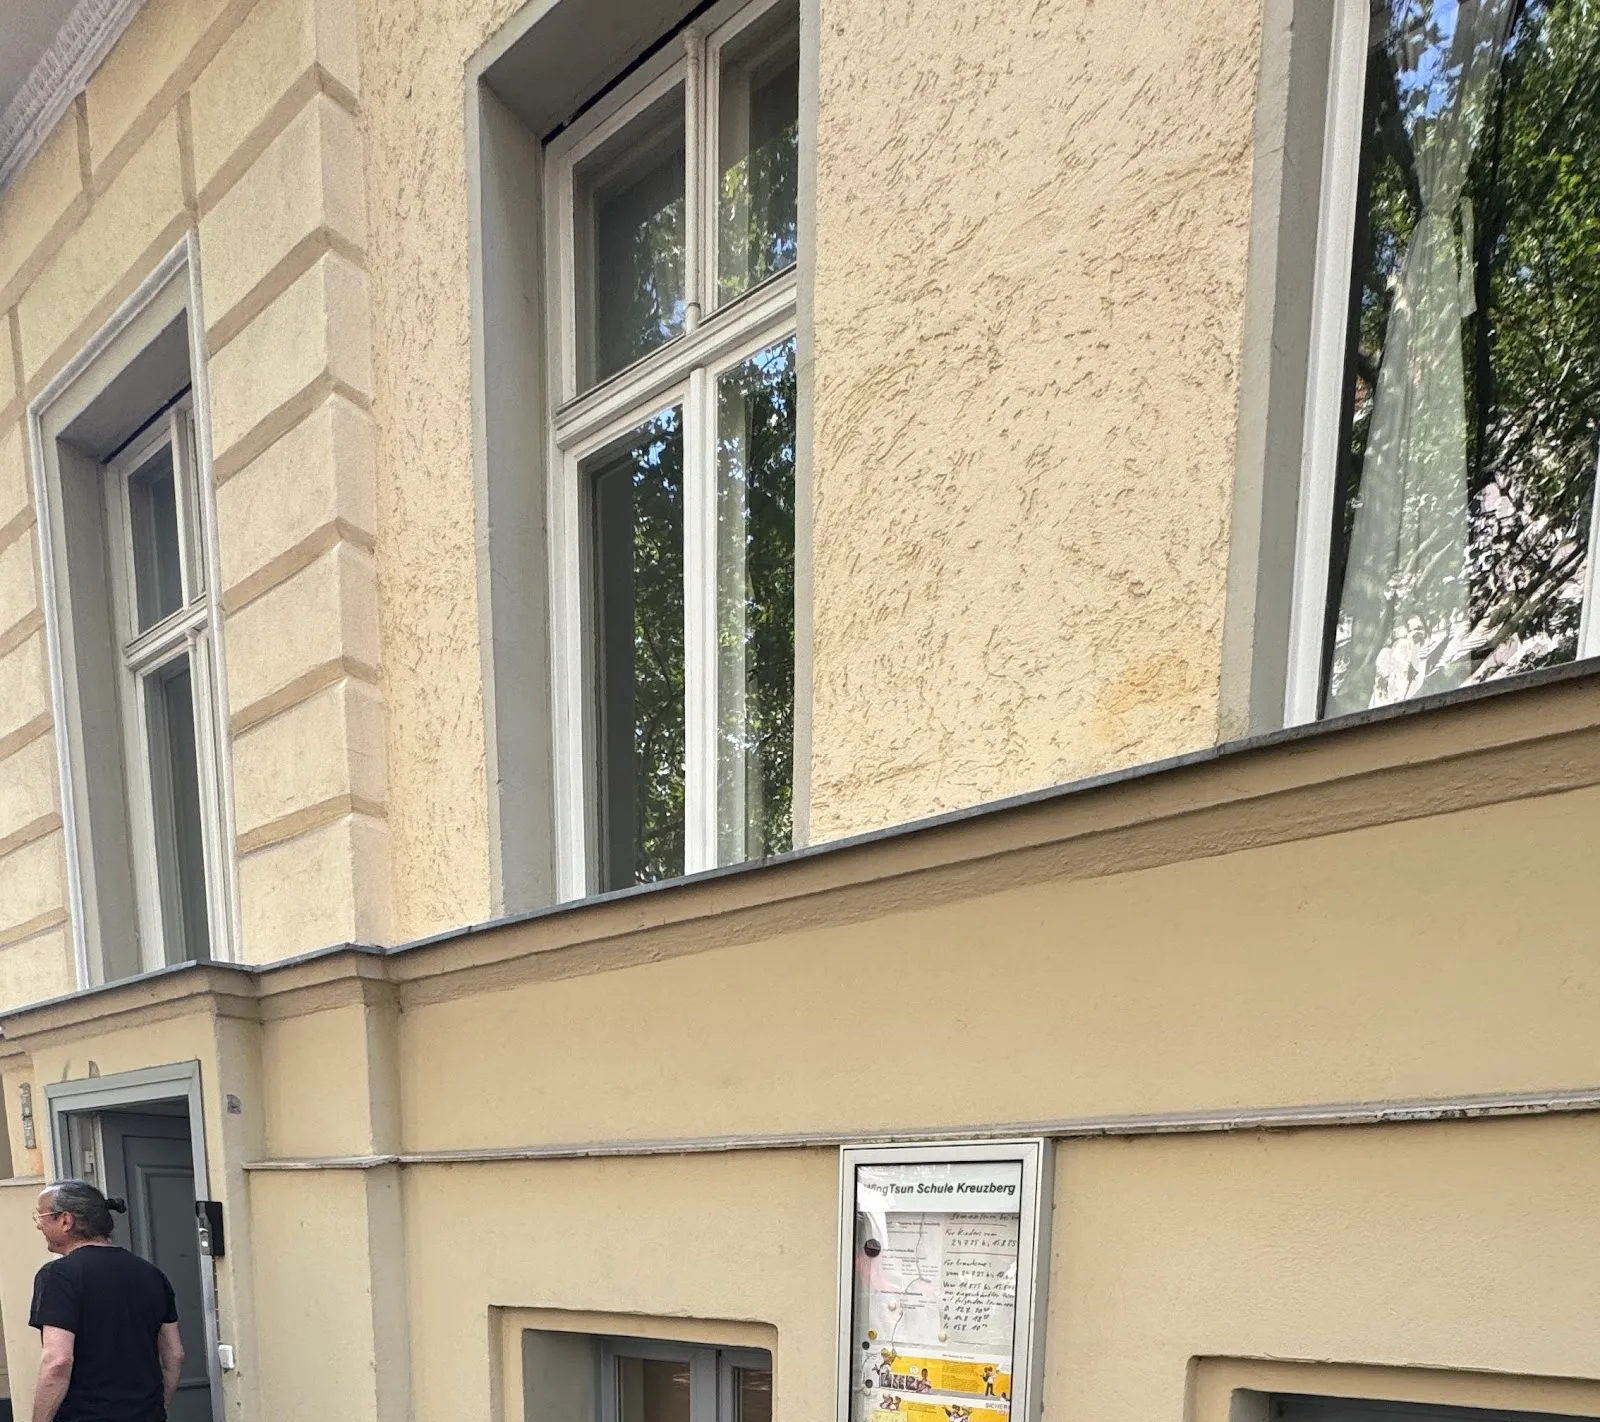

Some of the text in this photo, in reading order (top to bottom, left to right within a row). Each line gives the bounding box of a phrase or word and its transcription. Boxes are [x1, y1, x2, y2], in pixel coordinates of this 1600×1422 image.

[917, 1183, 953, 1194] Schule
[956, 1182, 1016, 1196] Kreuzberg
[985, 1402, 1010, 1411] SICHER
